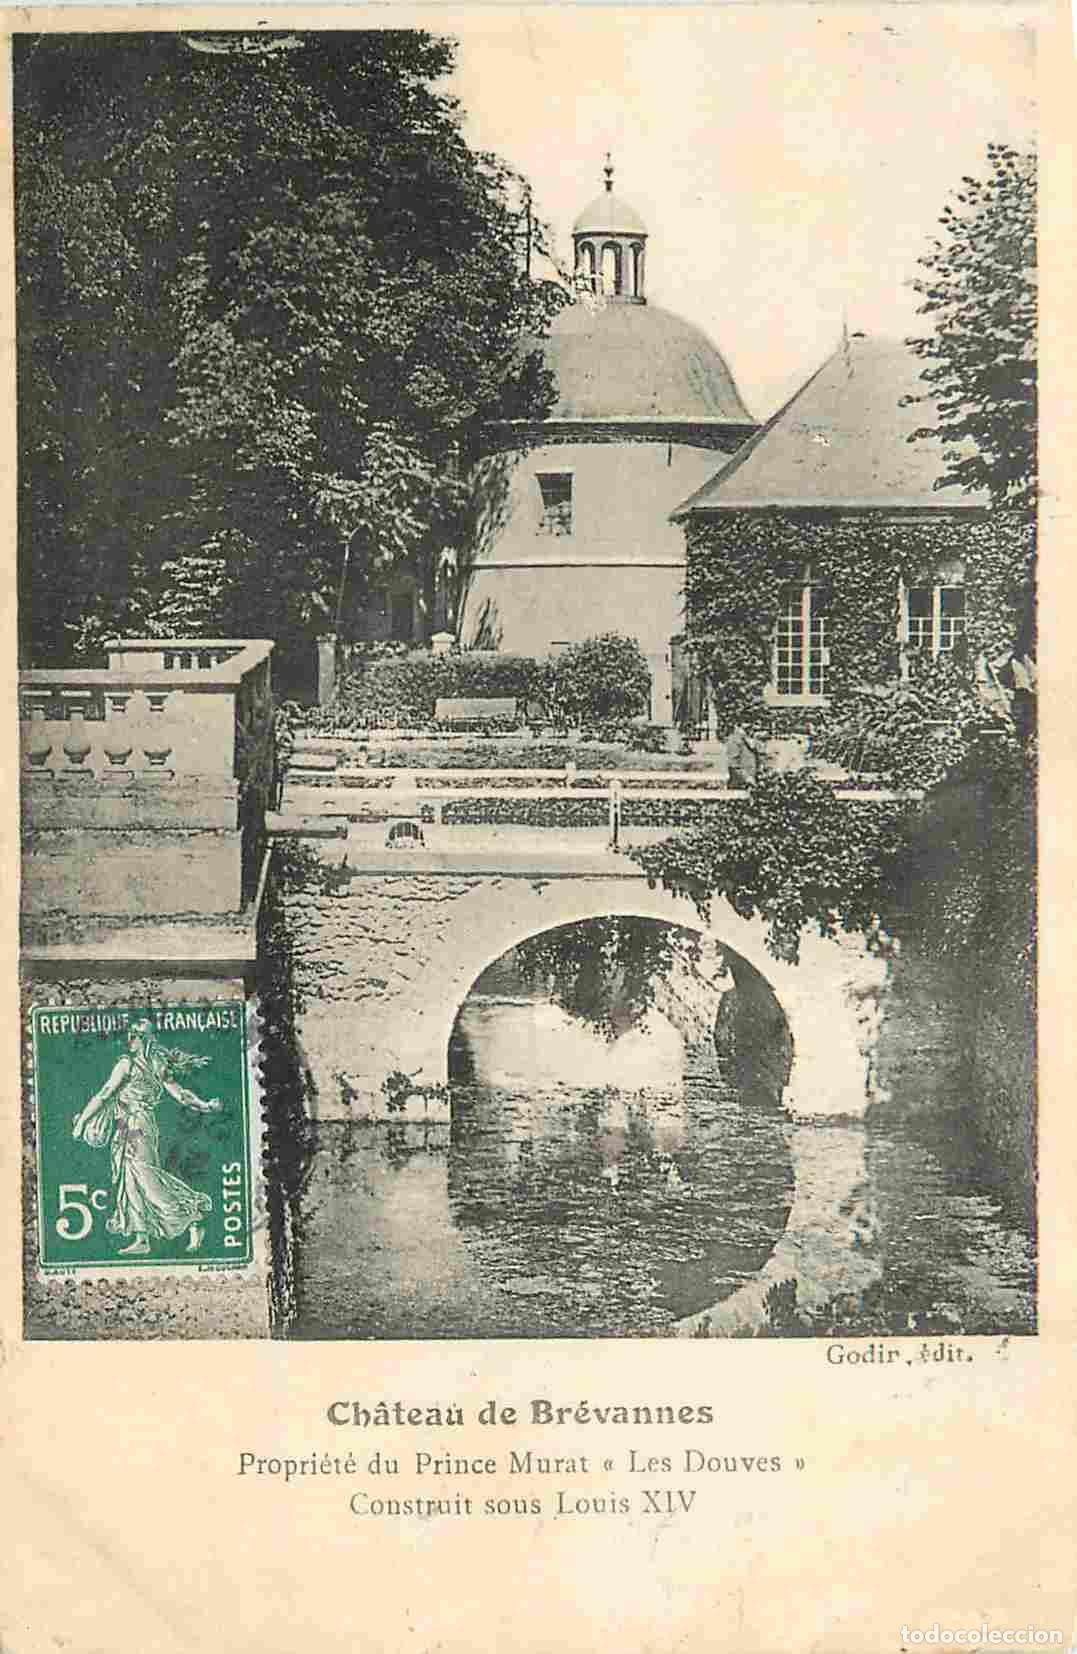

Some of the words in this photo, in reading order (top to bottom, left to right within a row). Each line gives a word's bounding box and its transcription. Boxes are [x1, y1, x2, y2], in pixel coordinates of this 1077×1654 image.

[223, 1161, 242, 1248] POSTES
[326, 1400, 464, 1428] Château
[477, 1401, 518, 1426] de
[529, 1399, 714, 1426] Brévannes
[237, 1451, 357, 1482] Propriété
[367, 1452, 400, 1475] du
[415, 1452, 497, 1475] Prince
[508, 1450, 590, 1474] Murat
[628, 1449, 672, 1473] Les
[682, 1449, 782, 1473] Douves
[349, 1491, 473, 1516] Construit
[483, 1497, 542, 1515] sous
[555, 1489, 631, 1515] Louis
[640, 1489, 697, 1514] XIV
